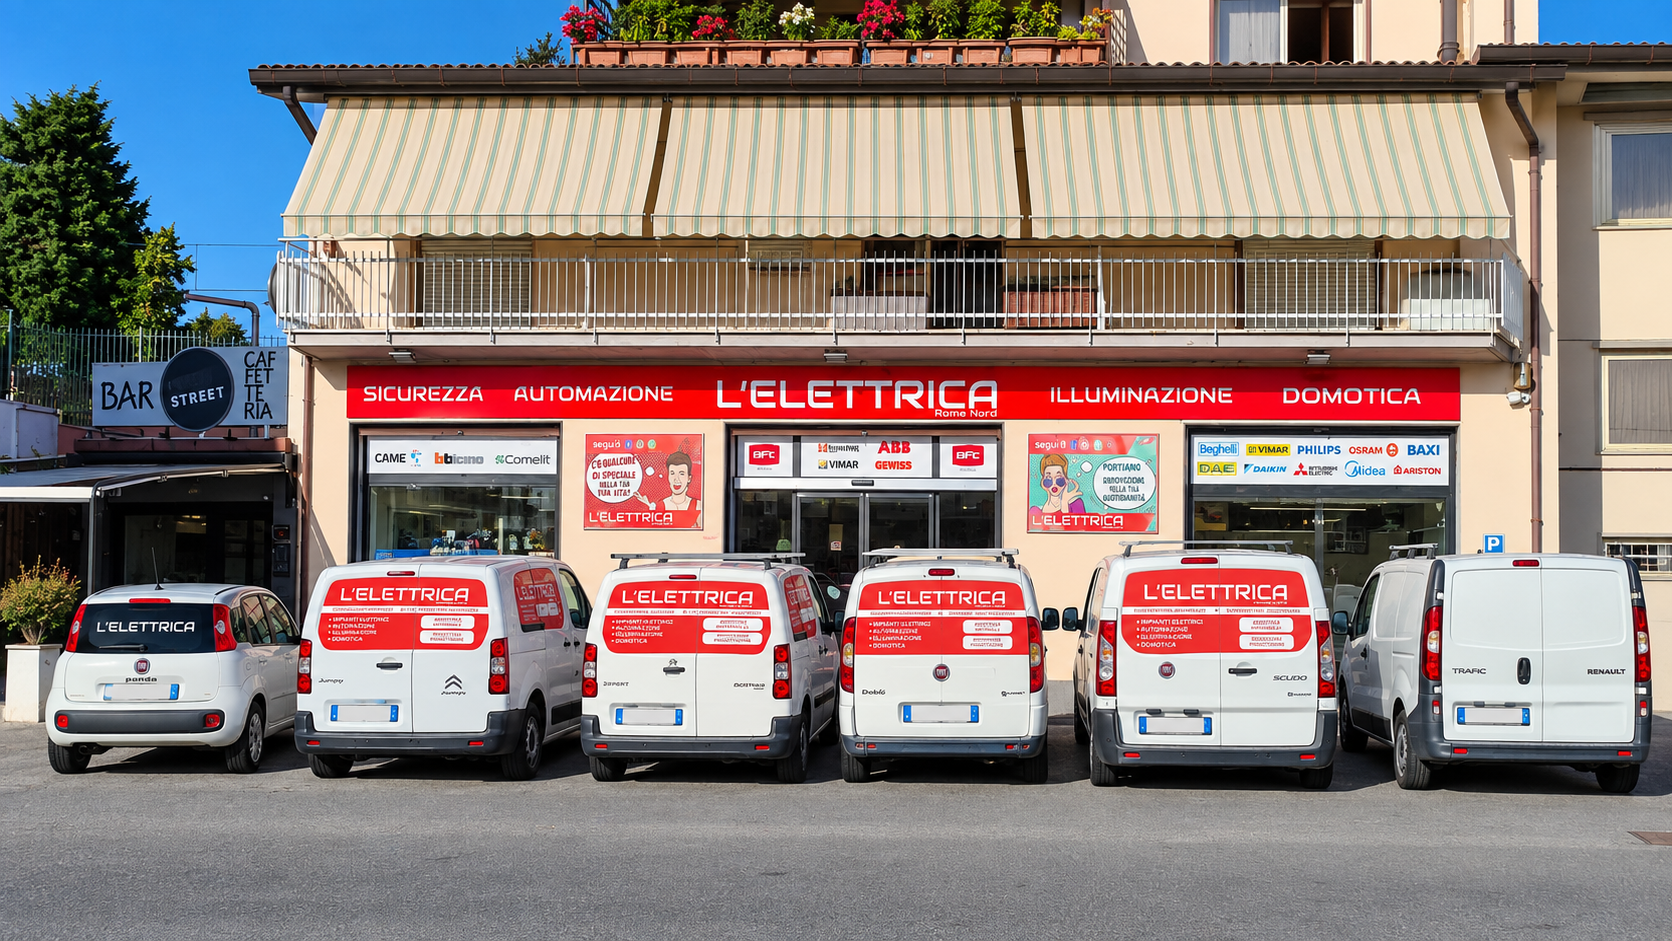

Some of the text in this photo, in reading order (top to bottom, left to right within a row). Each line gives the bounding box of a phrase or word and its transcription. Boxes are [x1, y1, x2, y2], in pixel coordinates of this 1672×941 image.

[101, 381, 154, 411] BAR
[171, 386, 224, 408] STREET
[363, 380, 1421, 410] SICUREZZA AUTOMAZIONE L'ELETTRICA ILLUMINAZIONE DOMOTICA
[970, 408, 998, 418] Nord
[878, 441, 911, 454] ABB
[1200, 443, 1237, 457] Beghelli
[1258, 446, 1289, 454] VIMAR
[1298, 445, 1342, 455] PHILIPS
[1349, 446, 1383, 455] OSRAM
[1407, 444, 1441, 456] BAXI
[375, 453, 406, 464] CAME
[505, 454, 551, 465] Comelit
[829, 460, 859, 469] VIMAR
[875, 460, 913, 470] GEWISS
[1253, 465, 1287, 473] DAIKIN
[602, 471, 636, 480] SPECIALE
[1403, 467, 1442, 475] ARISTON
[589, 512, 673, 522] L'ELETTRICA
[1033, 515, 1123, 526] L'ELETTRICA
[1488, 536, 1500, 551] P
[341, 587, 469, 602] L'ELETTRICA
[622, 590, 753, 605] L'ELETTRICA
[878, 590, 1006, 605] L'ELETTRICA
[1144, 584, 1287, 600] L'ELETTRICA
[97, 621, 196, 633] L'ELETTRICA
[1452, 667, 1487, 675] TRAFIC
